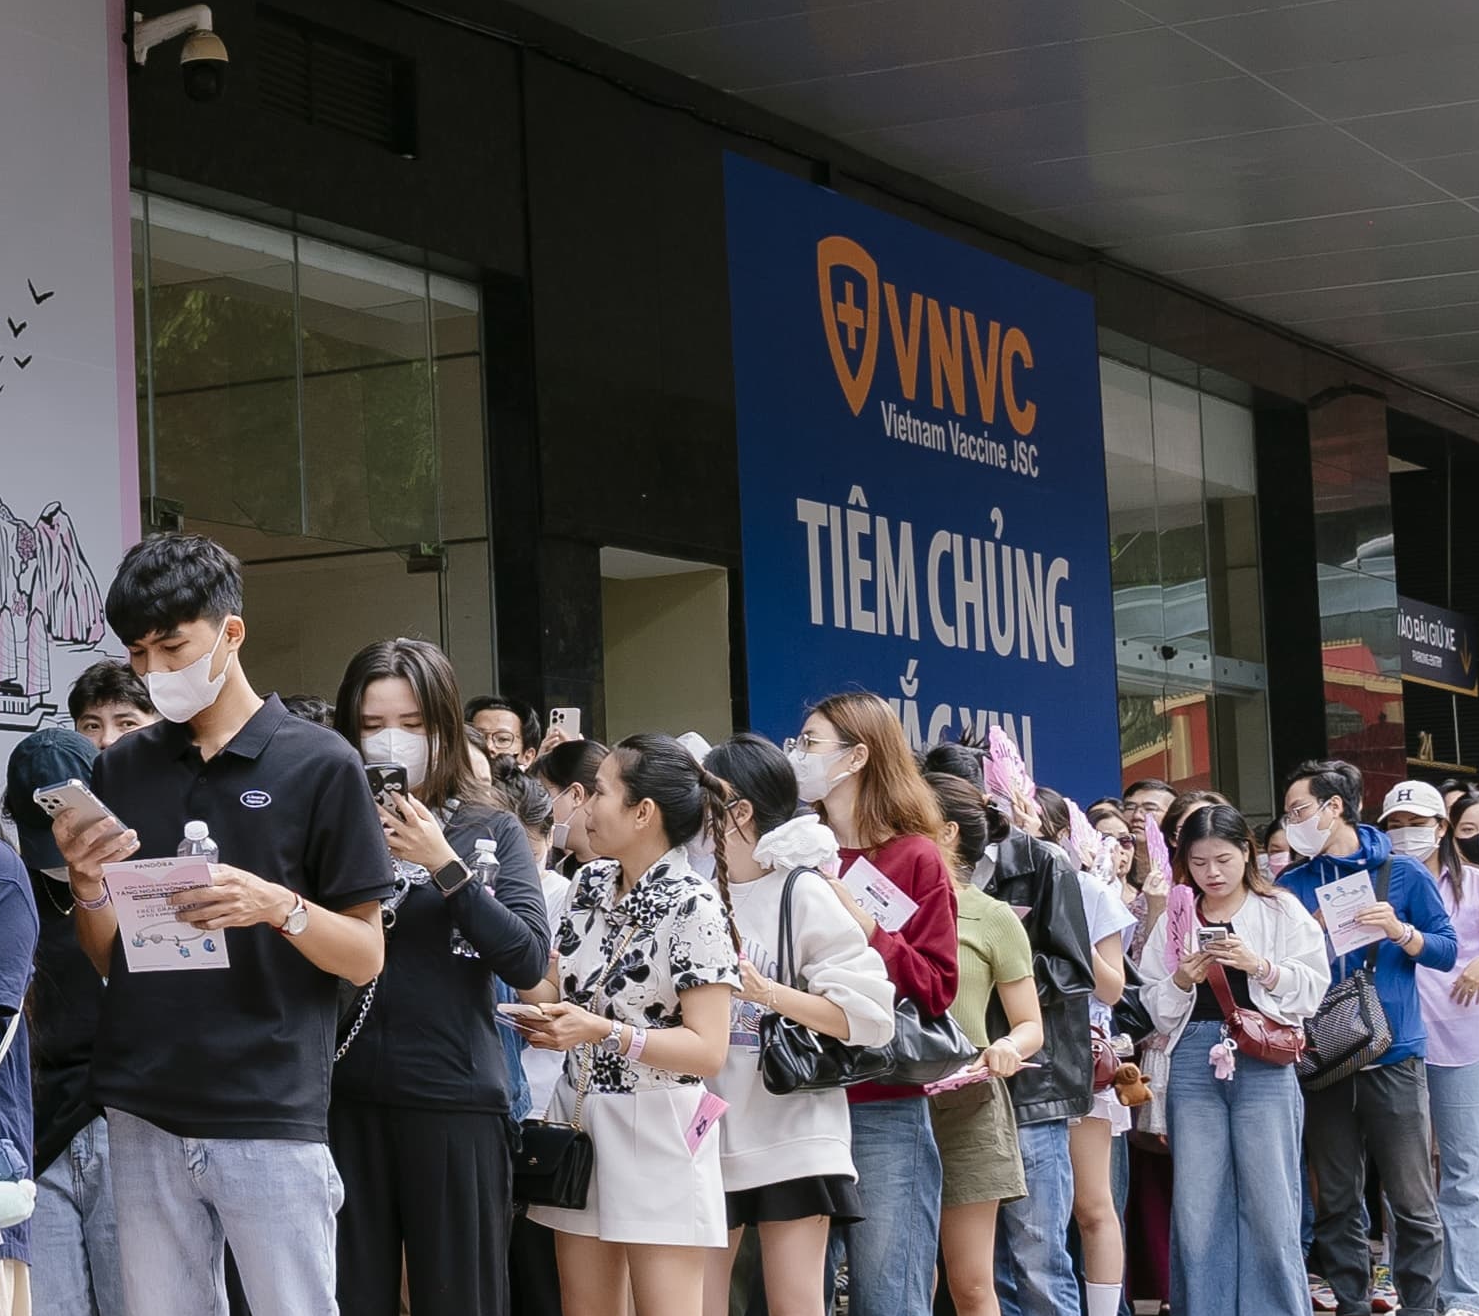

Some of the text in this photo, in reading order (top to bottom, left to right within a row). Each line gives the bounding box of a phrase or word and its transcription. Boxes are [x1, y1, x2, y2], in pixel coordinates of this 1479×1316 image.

[882, 280, 1037, 436] VNVC
[880, 400, 1040, 478] Vietnam Vaccine JSC
[796, 484, 1075, 668] TIÊM CHỦNG
[1396, 788, 1414, 802] H
